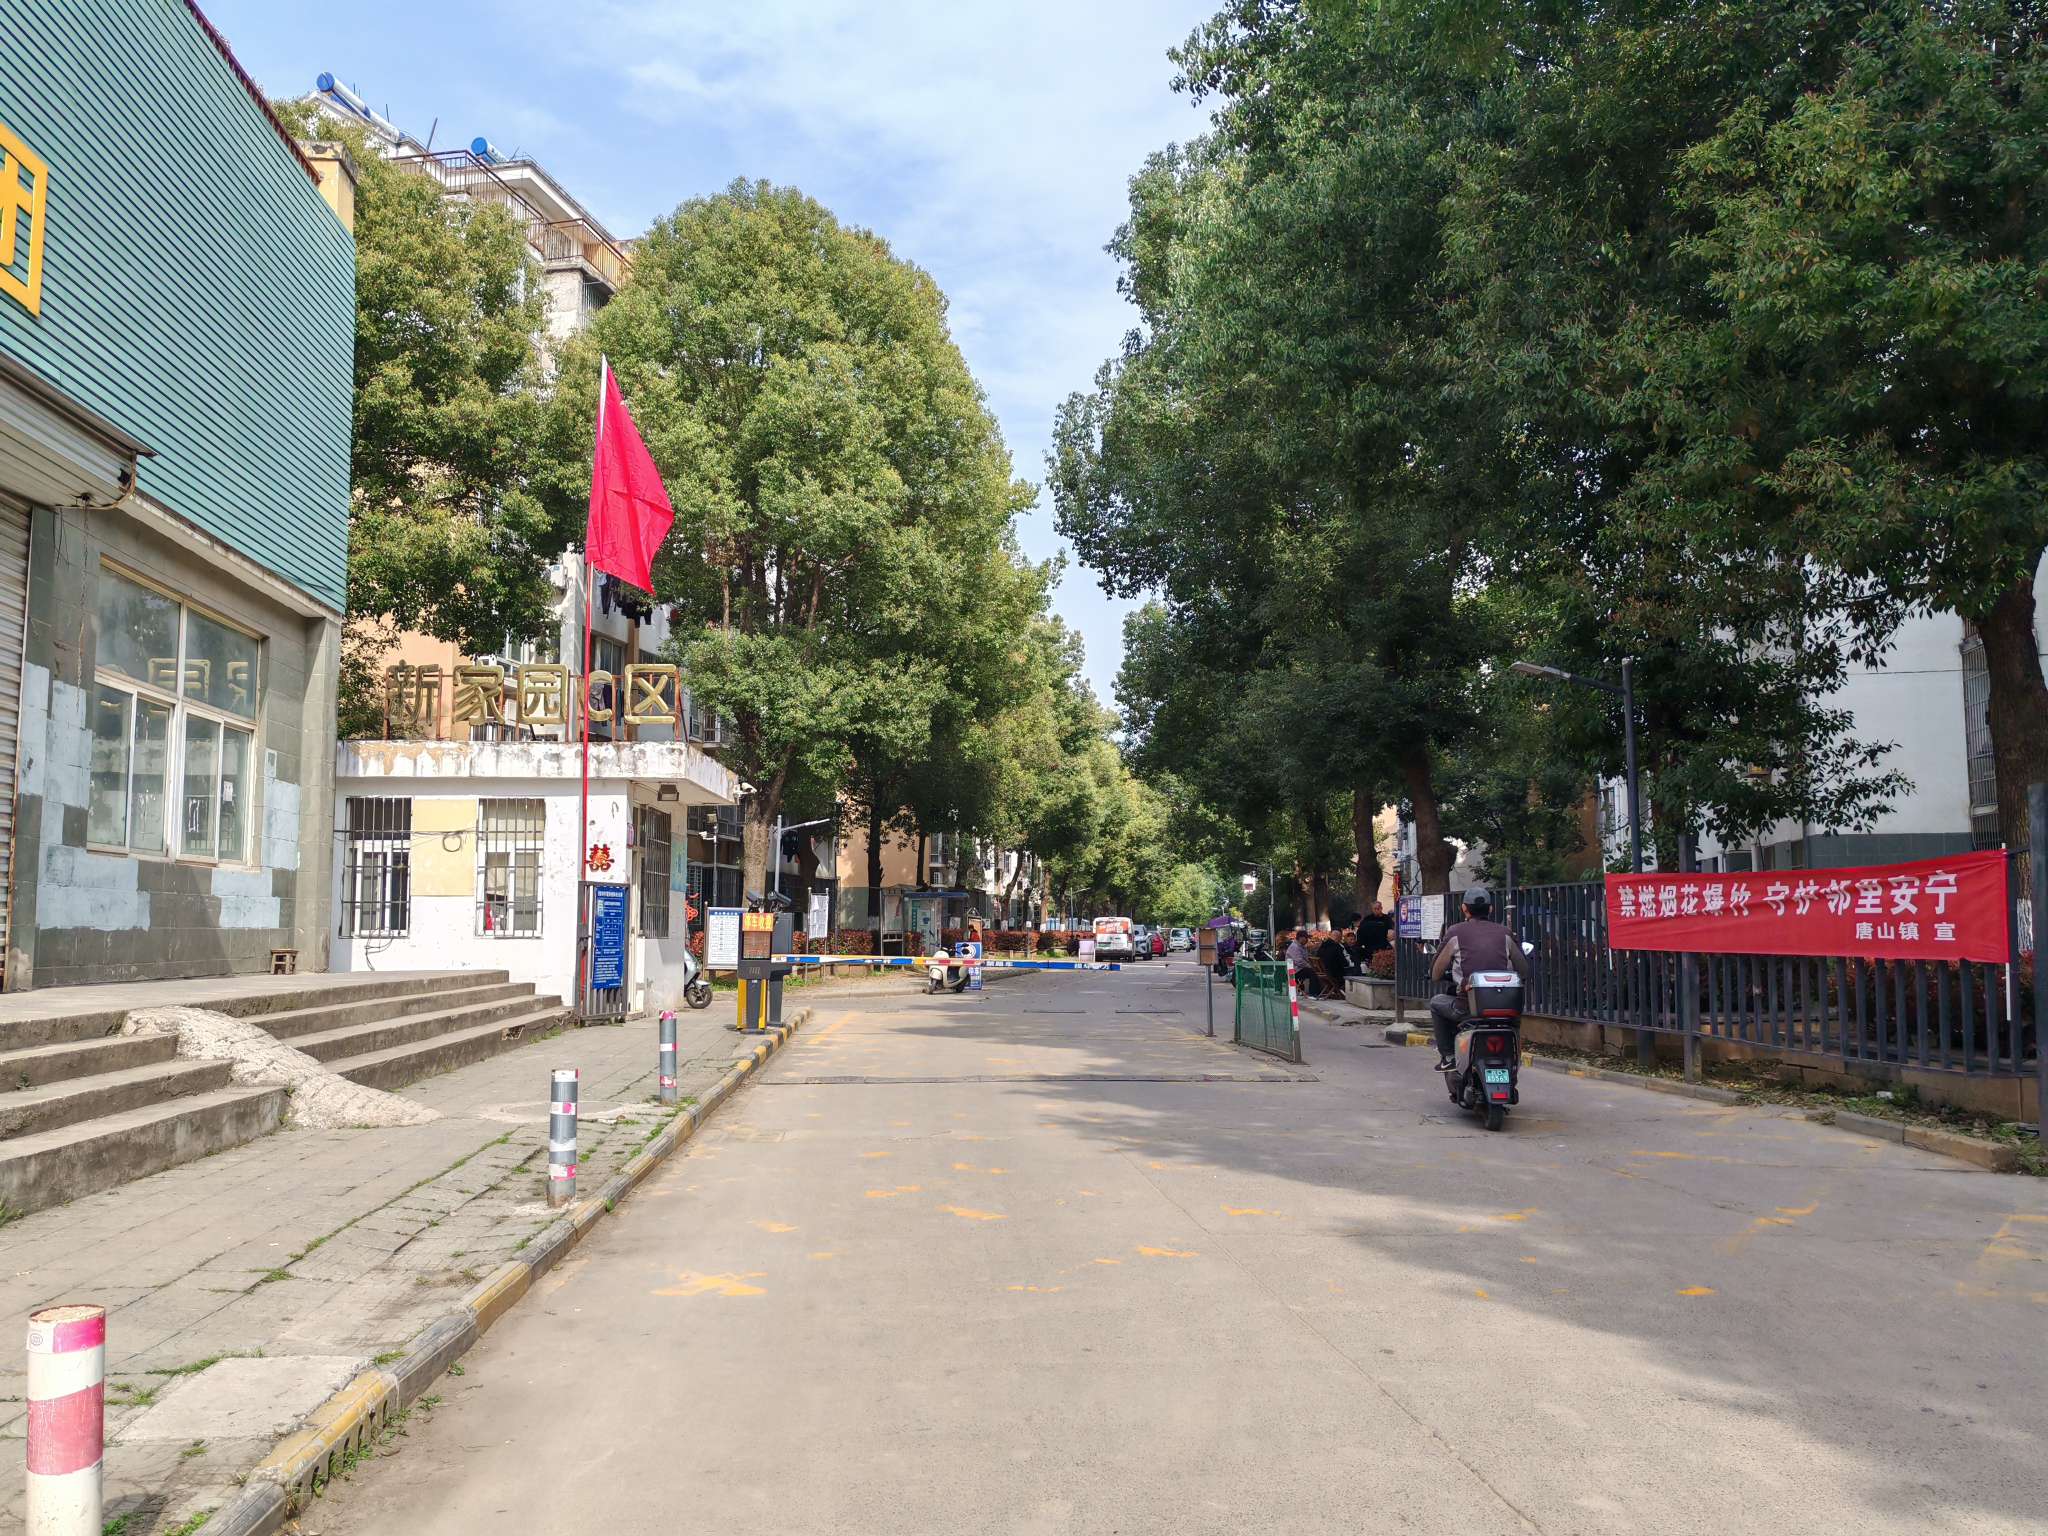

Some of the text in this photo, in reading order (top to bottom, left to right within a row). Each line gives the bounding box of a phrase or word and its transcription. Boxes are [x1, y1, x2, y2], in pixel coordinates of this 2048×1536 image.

[386, 659, 677, 726] 新家园C区
[1618, 869, 1958, 918] 禁燃烟花爆竹 守护邻里安宁
[1856, 922, 1956, 941] 唐山镇 宣
